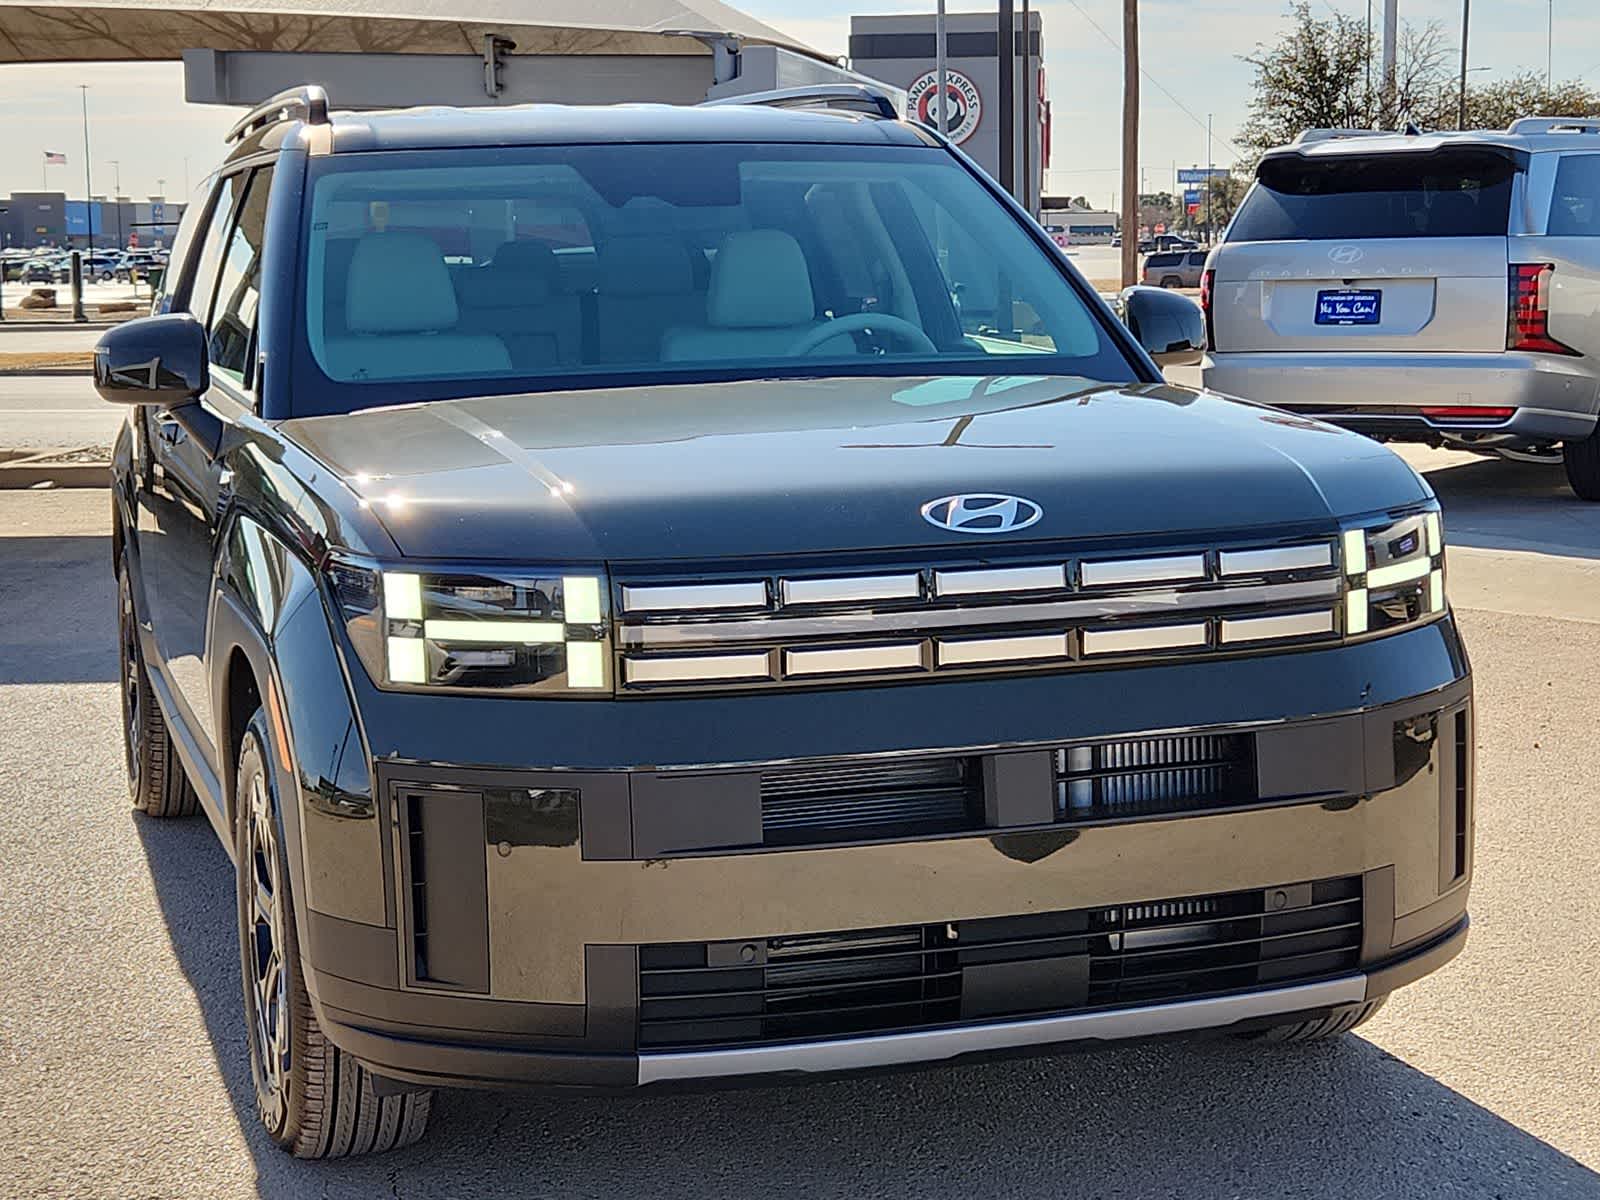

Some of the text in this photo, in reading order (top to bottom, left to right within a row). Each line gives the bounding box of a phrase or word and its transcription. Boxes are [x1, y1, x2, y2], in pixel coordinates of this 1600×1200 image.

[907, 73, 978, 111] PANDA XPRESS
[1320, 302, 1377, 314] Yes You Can!
